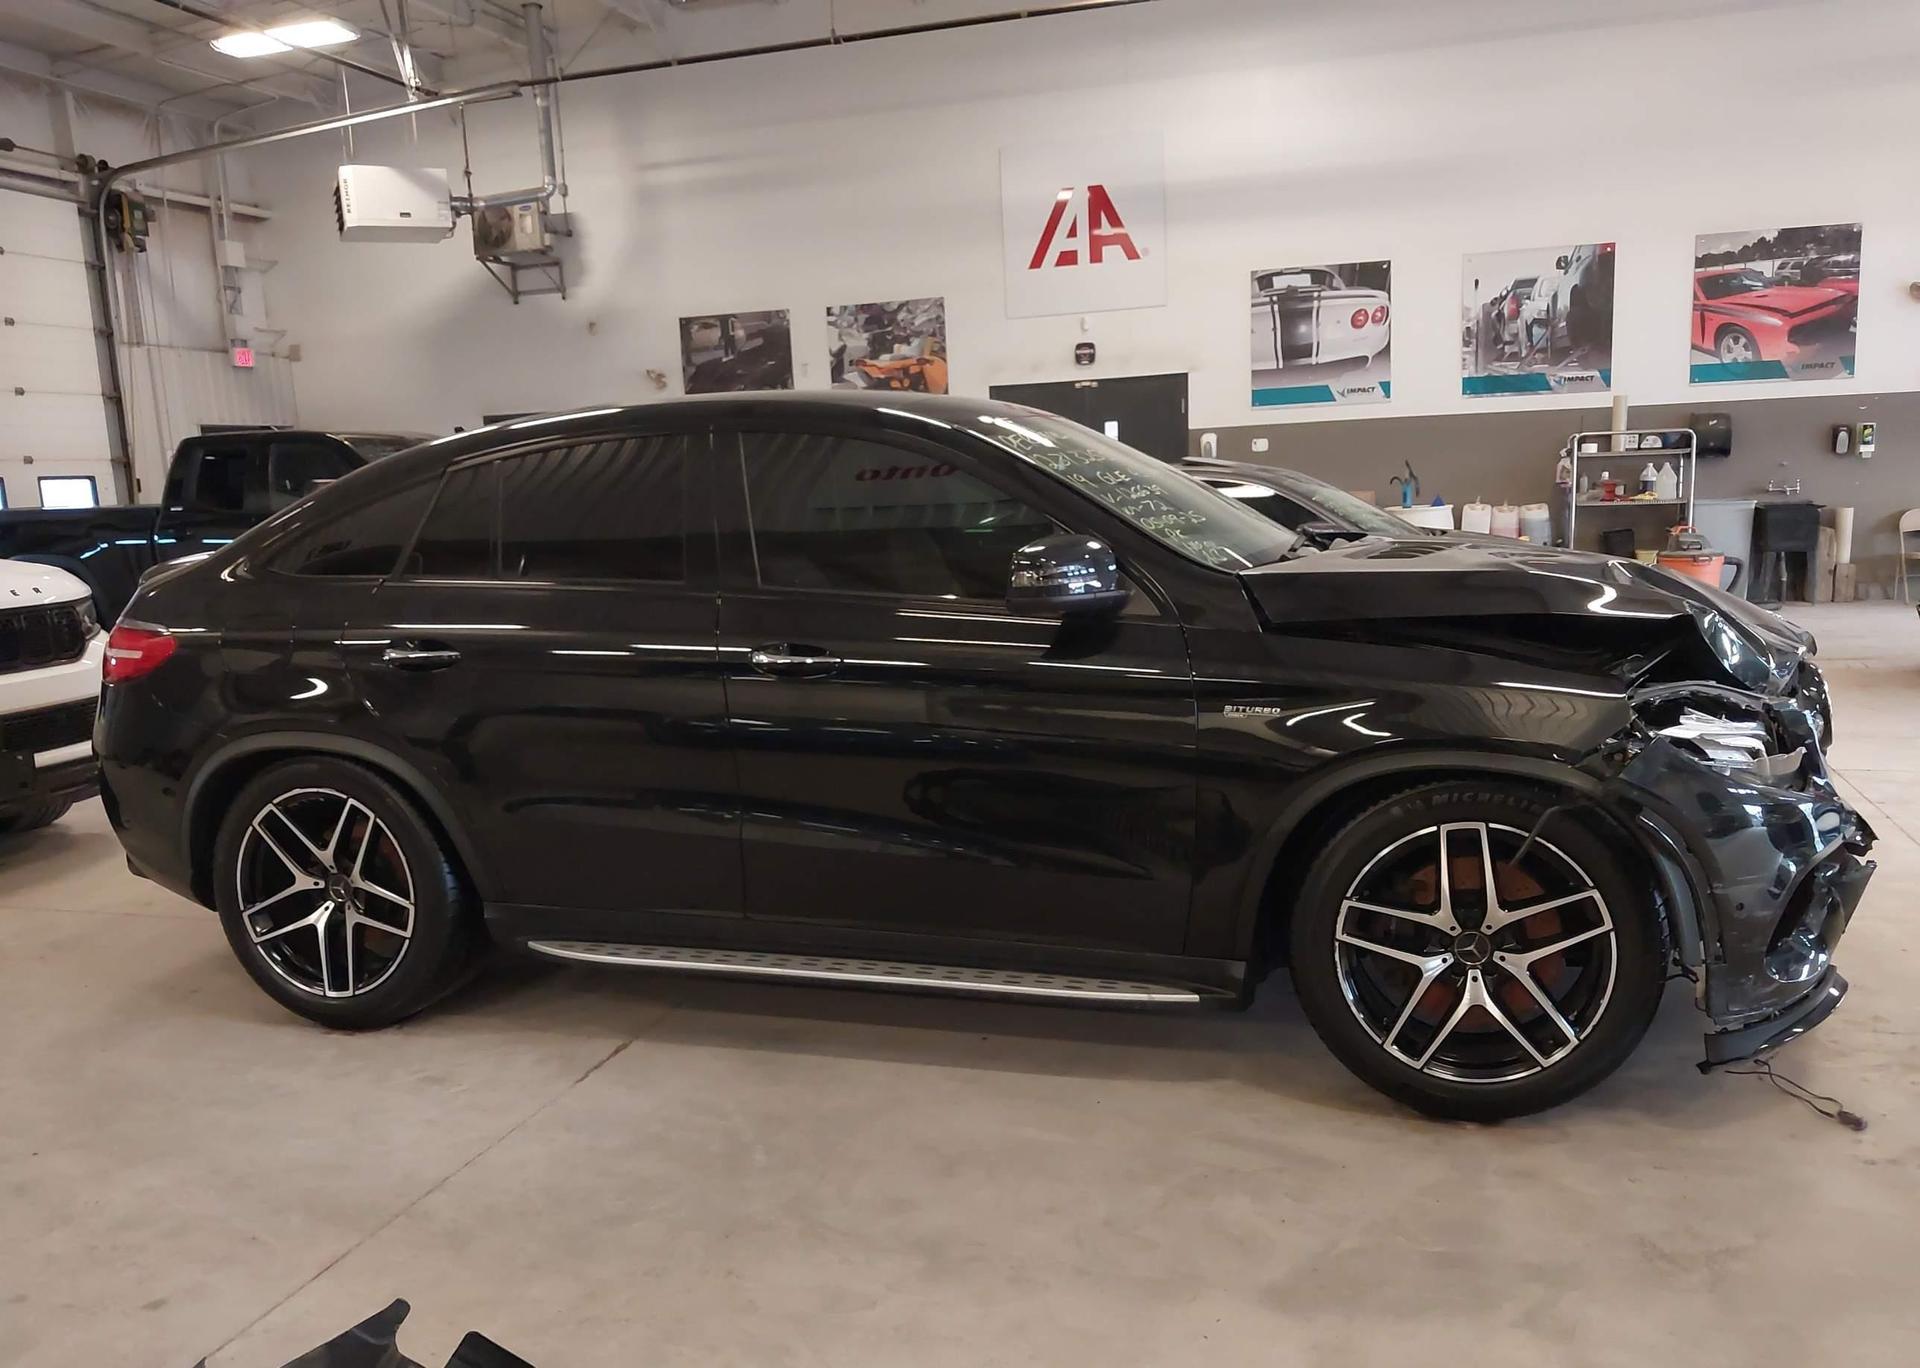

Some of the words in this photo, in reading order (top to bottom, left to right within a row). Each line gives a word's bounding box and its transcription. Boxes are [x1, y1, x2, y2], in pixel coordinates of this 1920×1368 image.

[1564, 375, 1595, 383] IMPACT
[1346, 386, 1376, 394] IMPACT
[1096, 470, 1131, 485] GLE
[1224, 705, 1280, 715] BITURBO
